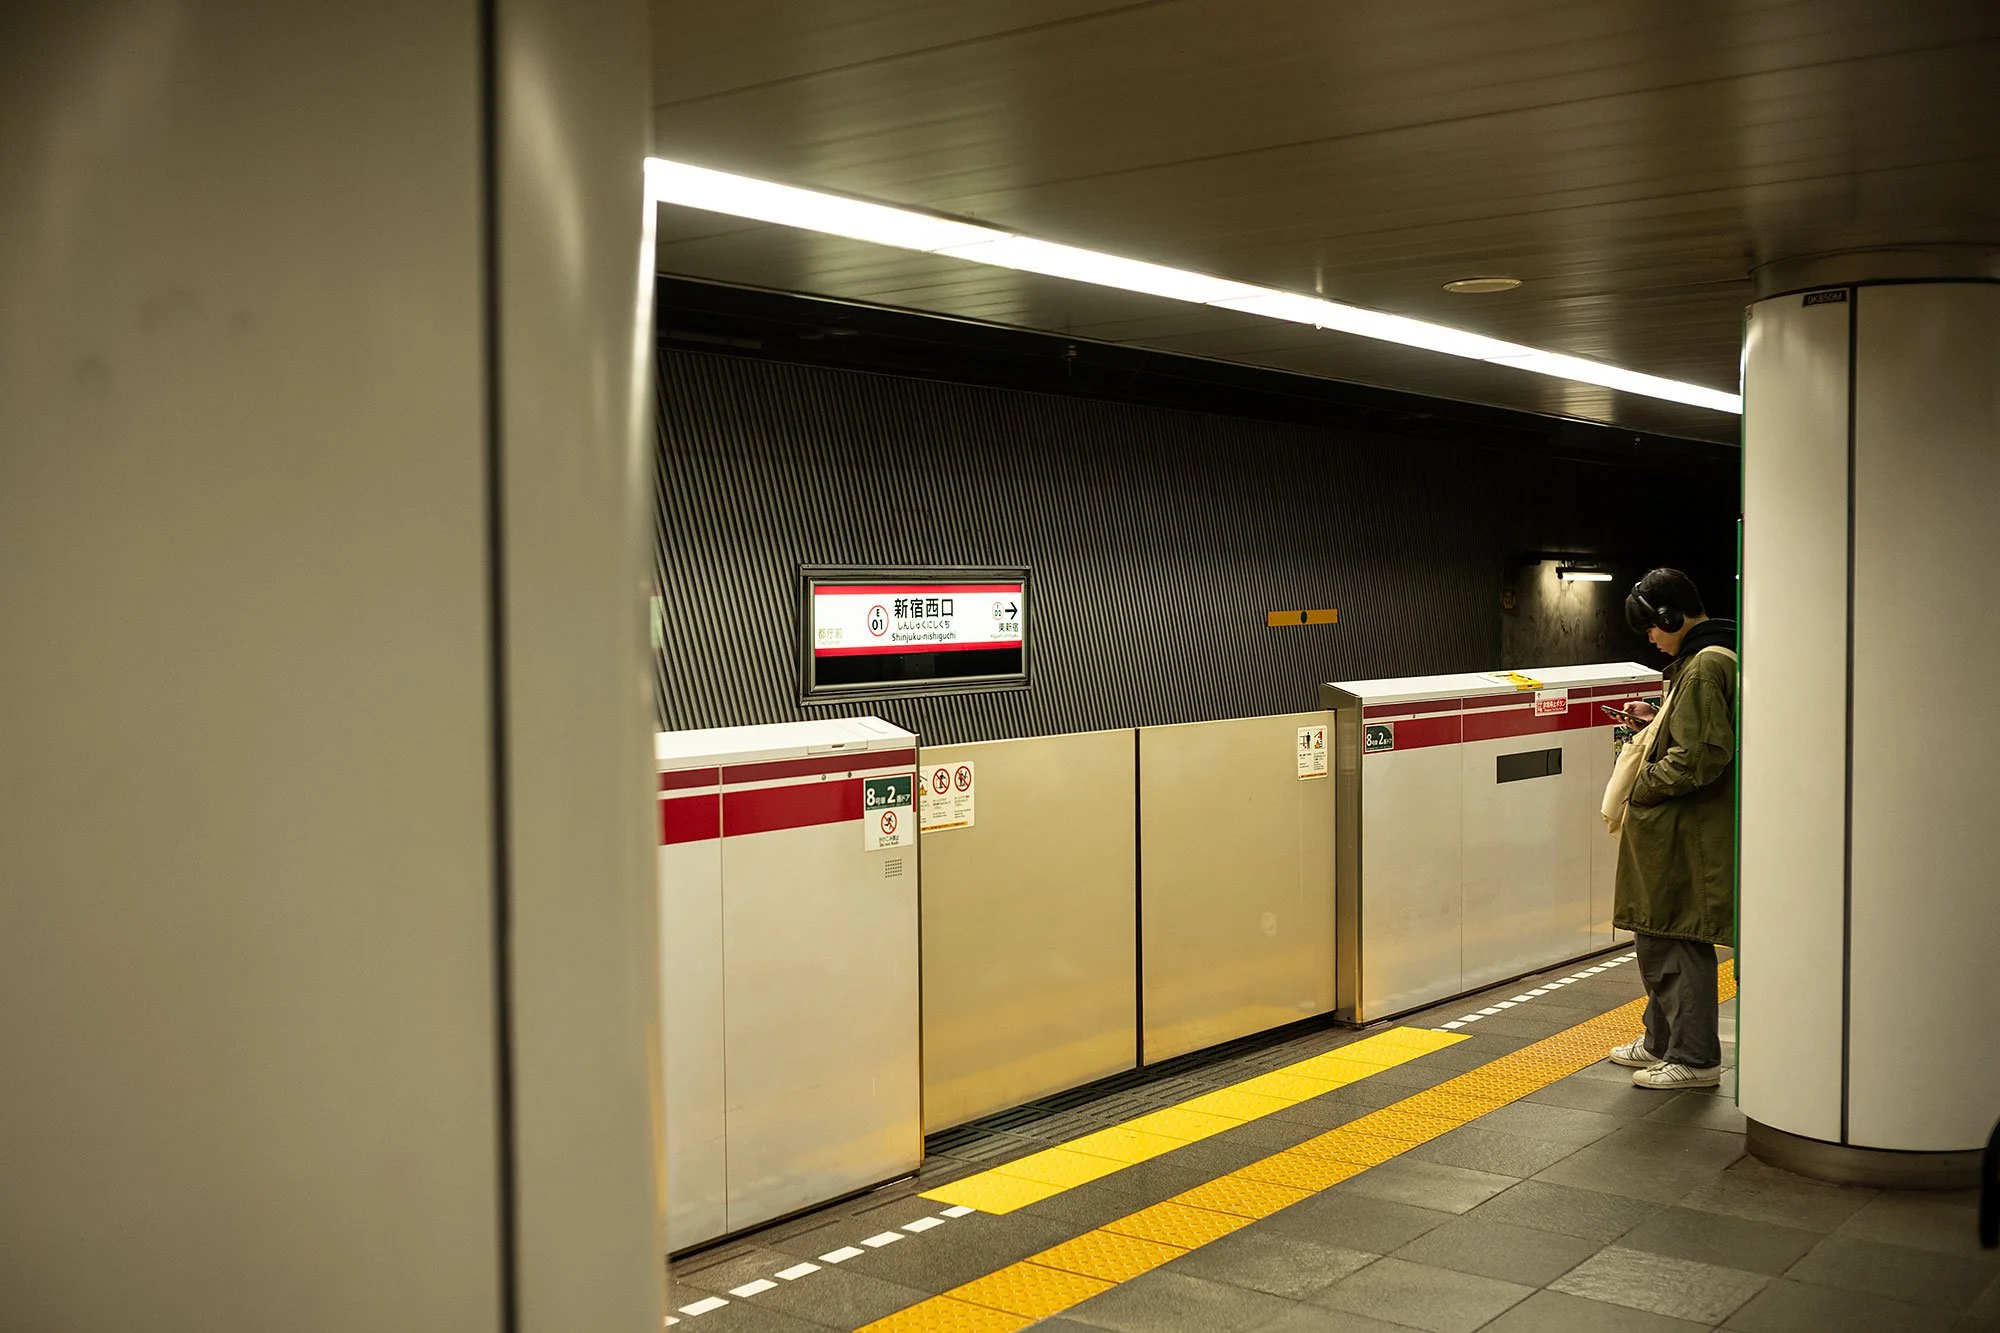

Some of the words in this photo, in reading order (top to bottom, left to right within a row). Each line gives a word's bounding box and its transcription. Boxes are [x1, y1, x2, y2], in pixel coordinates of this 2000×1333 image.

[876, 608, 880, 618] E
[894, 598, 954, 619] 新宿西口
[871, 619, 883, 631] 01
[897, 620, 951, 630] しんじゅくにしくち
[891, 630, 956, 643] Shinjuku-nishiguchi
